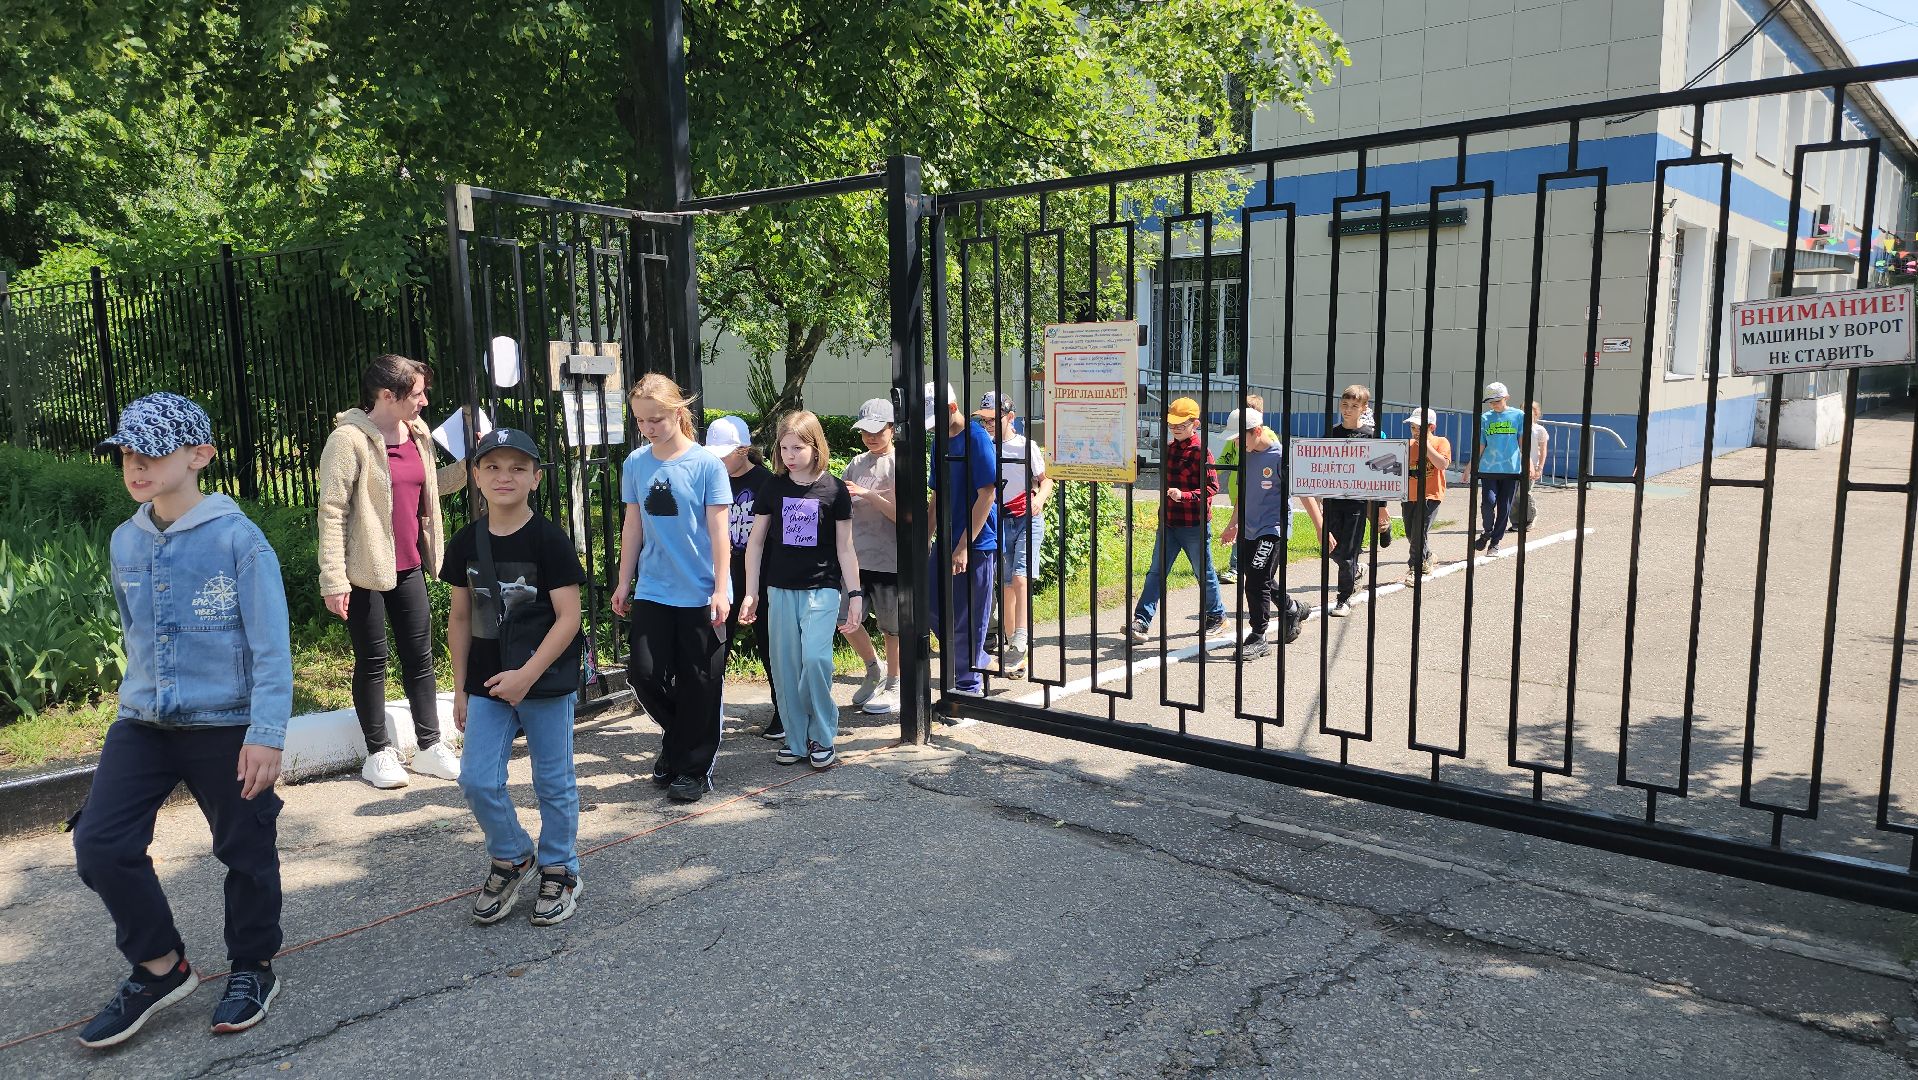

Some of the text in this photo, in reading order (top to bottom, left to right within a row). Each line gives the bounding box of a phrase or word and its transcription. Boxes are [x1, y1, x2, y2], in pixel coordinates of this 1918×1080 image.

[1740, 294, 1905, 326] ВНИМАНИЕ!
[1742, 318, 1904, 345] МАШИНЫ У ВОРОТ
[1768, 344, 1874, 364] НЕ СТАВИТЬ
[1055, 387, 1128, 399] ПРИГЛАШАЕТ!
[1297, 445, 1370, 458] ВНИМАНИЕ!
[1311, 461, 1355, 474] ВЕДЁТСЯ
[1296, 478, 1401, 492] ВИДЕОНАБЛЮДЕНИЕ
[784, 499, 805, 516] good
[1252, 540, 1274, 569] SKATE
[194, 608, 217, 616] VIBES
